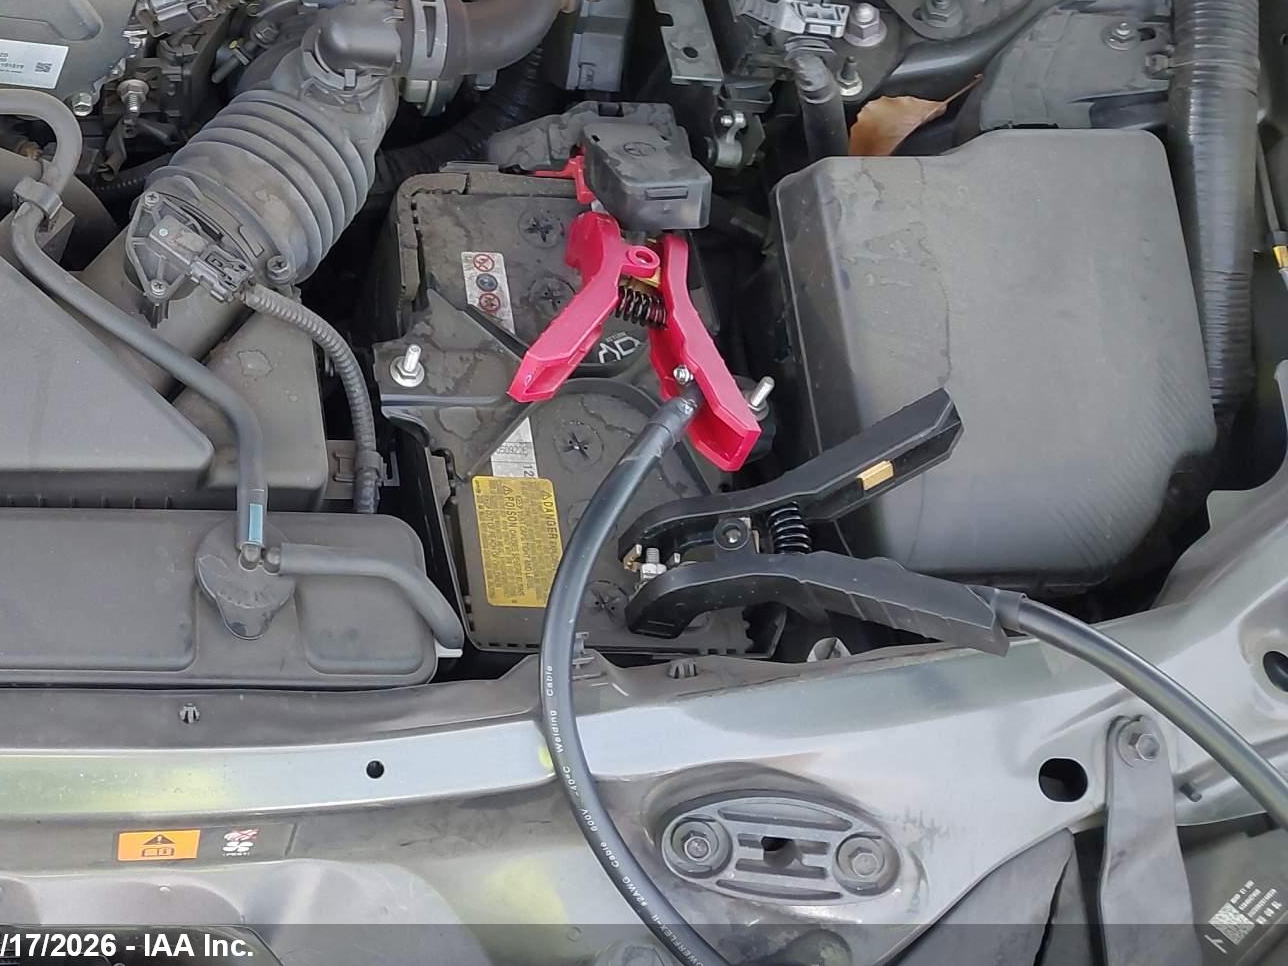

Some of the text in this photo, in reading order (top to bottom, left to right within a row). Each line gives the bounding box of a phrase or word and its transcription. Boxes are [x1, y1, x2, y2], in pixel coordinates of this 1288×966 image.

[504, 496, 517, 527] POISON
[544, 501, 558, 540] DANGER
[550, 710, 564, 753] Welding
[600, 841, 619, 868] Cable
